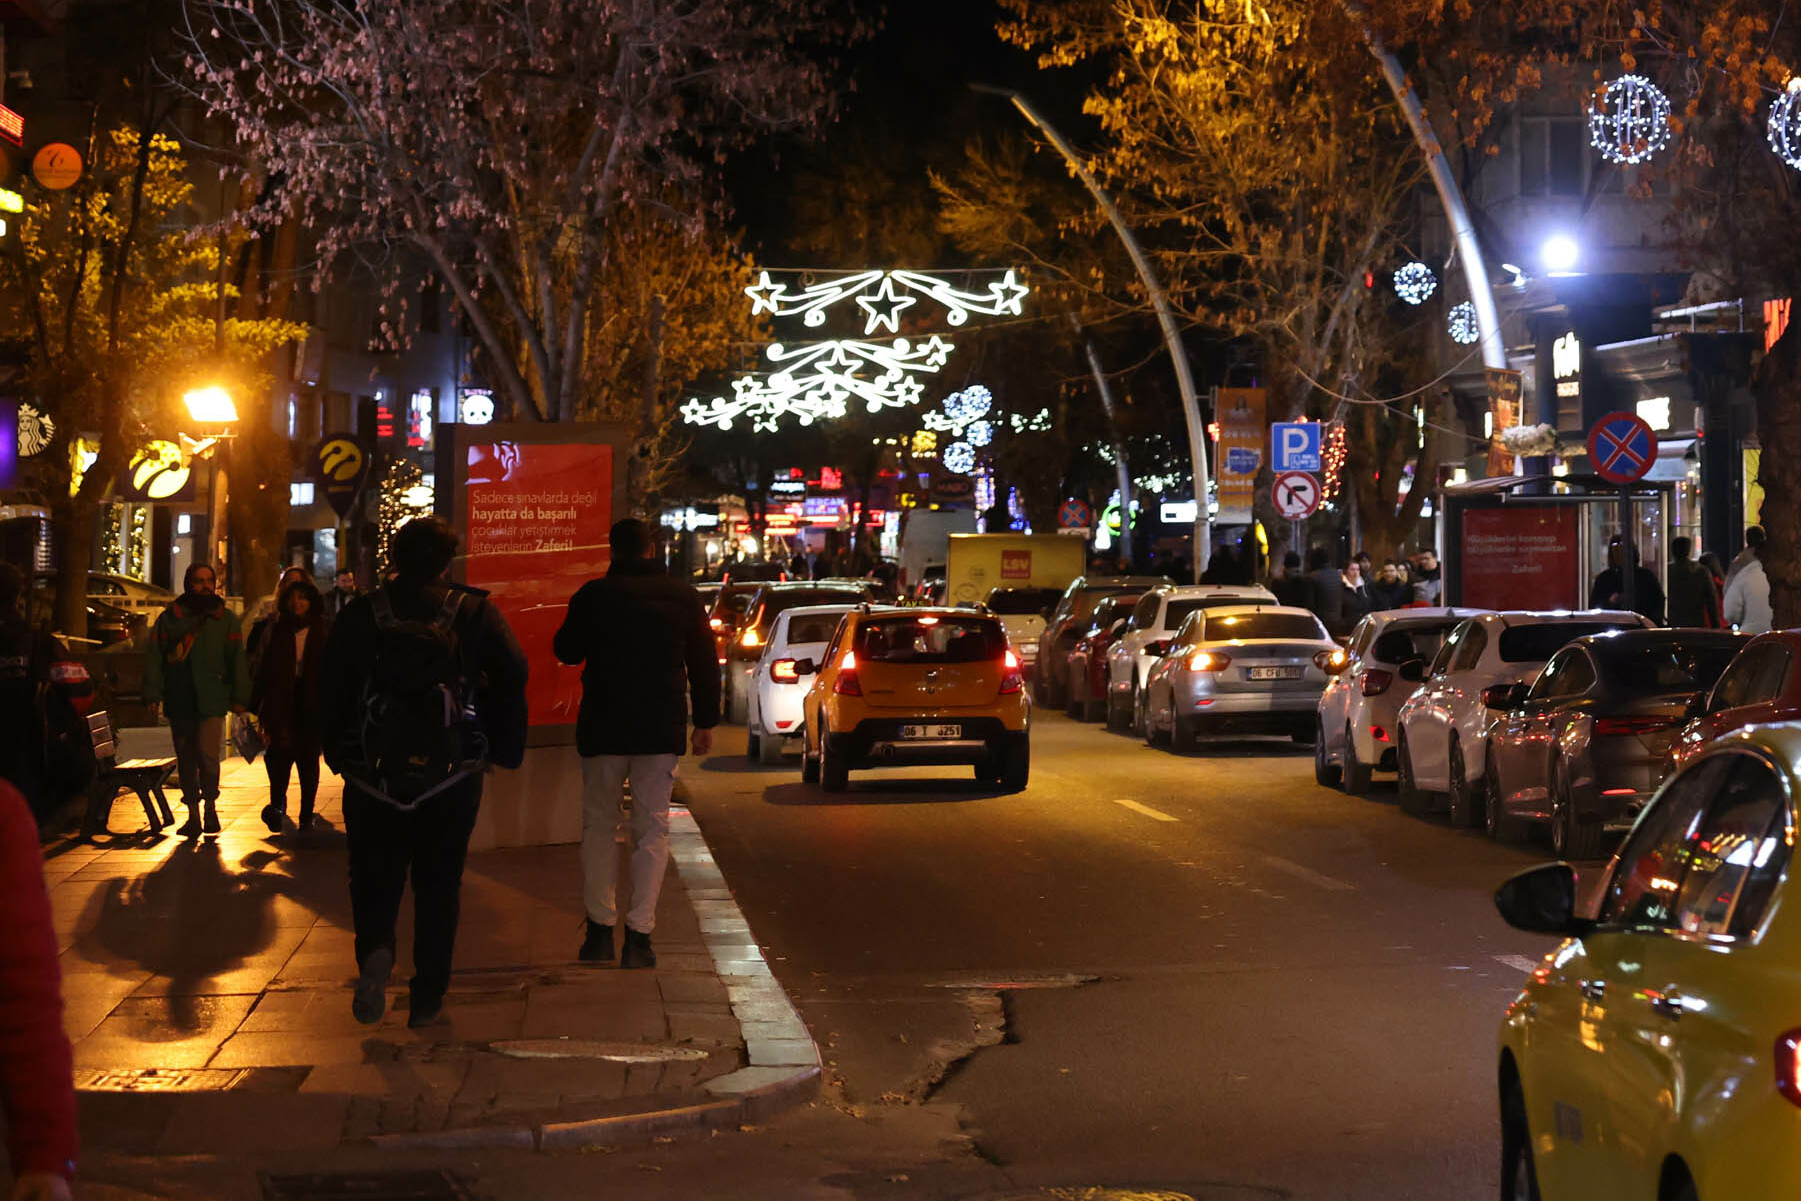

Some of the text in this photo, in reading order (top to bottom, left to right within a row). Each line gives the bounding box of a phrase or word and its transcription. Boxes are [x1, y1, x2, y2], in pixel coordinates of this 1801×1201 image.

[1283, 428, 1310, 467] P
[473, 490, 513, 504] Sadece
[472, 506, 577, 523] hayatta da başarılı
[535, 539, 573, 552] Zaferi!
